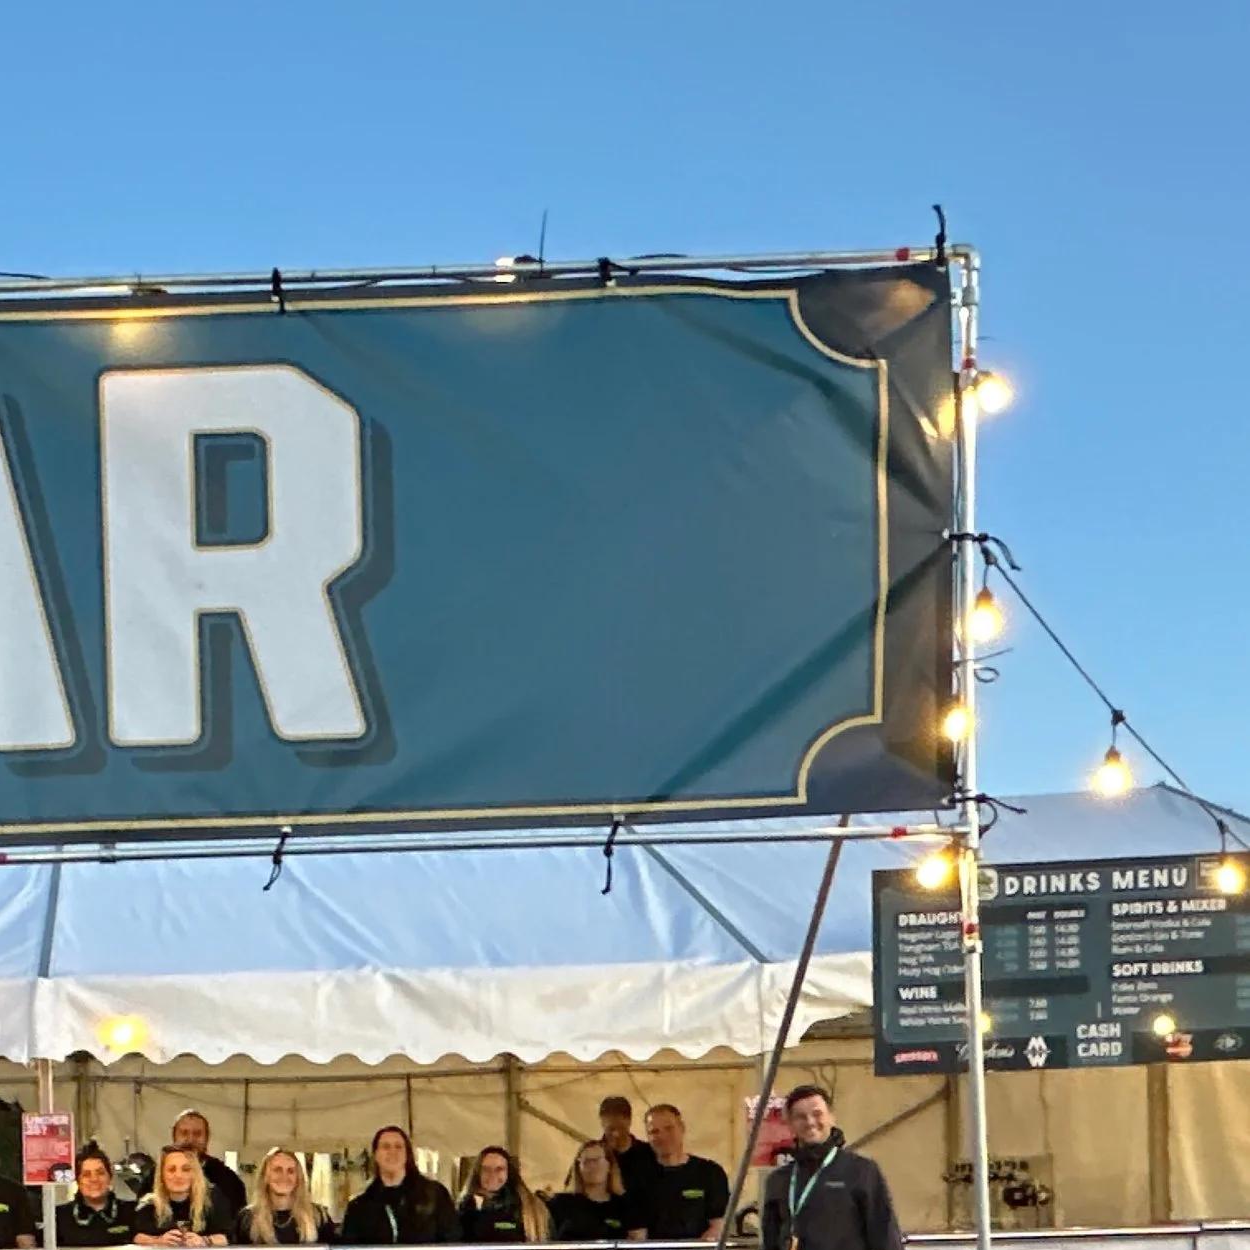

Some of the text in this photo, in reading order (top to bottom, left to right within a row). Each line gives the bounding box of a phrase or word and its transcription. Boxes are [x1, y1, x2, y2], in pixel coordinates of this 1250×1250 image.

[1004, 871, 1100, 897] DRINKS
[1112, 864, 1188, 890] MENU
[1112, 963, 1148, 977] SOFT
[899, 986, 938, 1000] WINE
[1076, 1022, 1121, 1038] CASH
[1077, 1041, 1123, 1057] CARD
